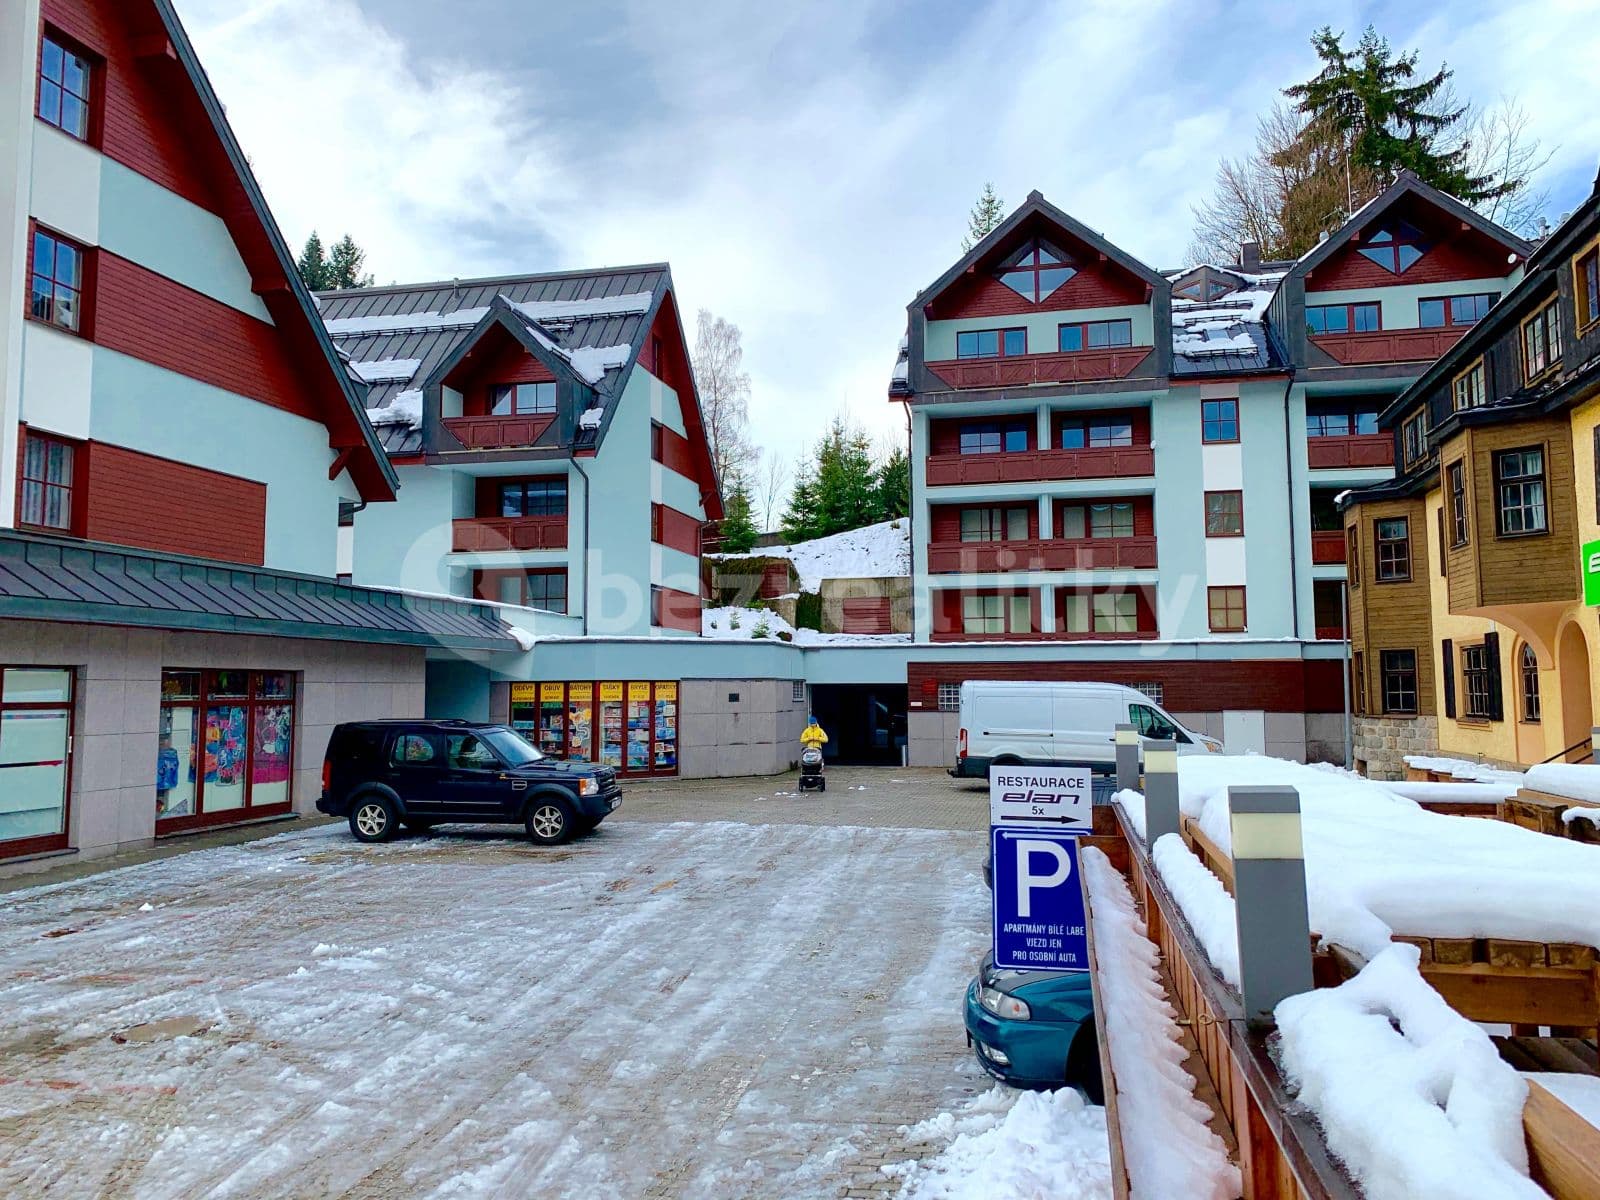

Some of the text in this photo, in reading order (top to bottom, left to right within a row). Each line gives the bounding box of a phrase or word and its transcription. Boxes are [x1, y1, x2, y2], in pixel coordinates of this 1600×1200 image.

[997, 776, 1085, 789] RESTAURACE
[1002, 789, 1080, 805] elan
[1031, 805, 1045, 816] 5x
[1016, 839, 1072, 918] P
[1003, 923, 1085, 936] APARTMÁNY BÍLÉ LABE
[1026, 937, 1063, 949] VJEZD JEN
[1012, 950, 1077, 963] PRO OSOBNÍ AUTA
